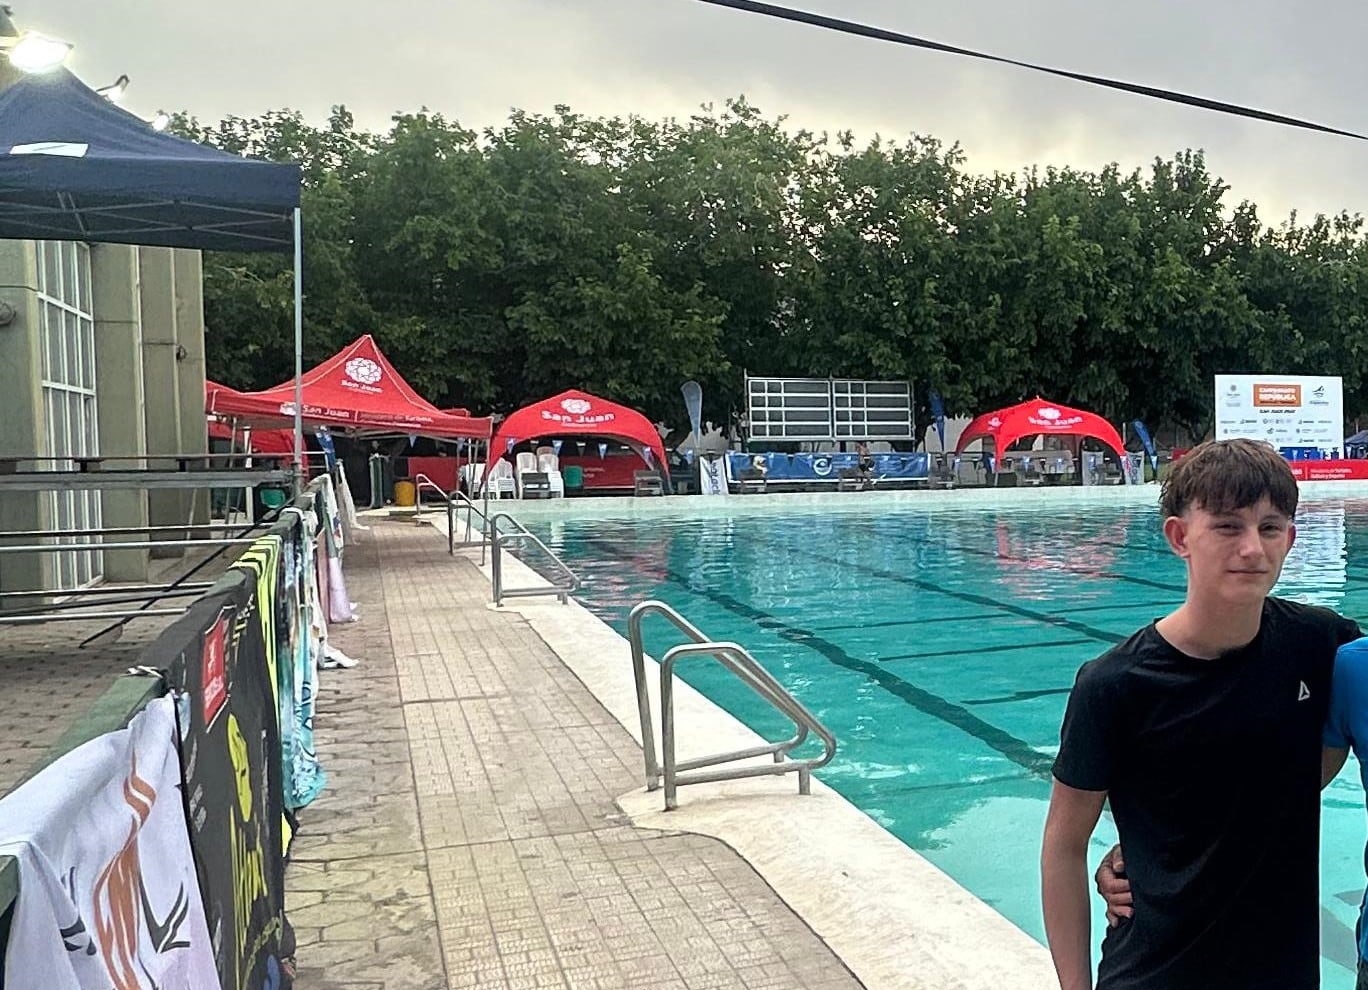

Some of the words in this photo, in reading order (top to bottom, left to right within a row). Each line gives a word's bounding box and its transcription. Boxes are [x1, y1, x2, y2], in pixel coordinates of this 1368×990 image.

[302, 404, 323, 416] San
[323, 406, 351, 419] Juan
[541, 410, 572, 425] San
[575, 410, 616, 424] Juan
